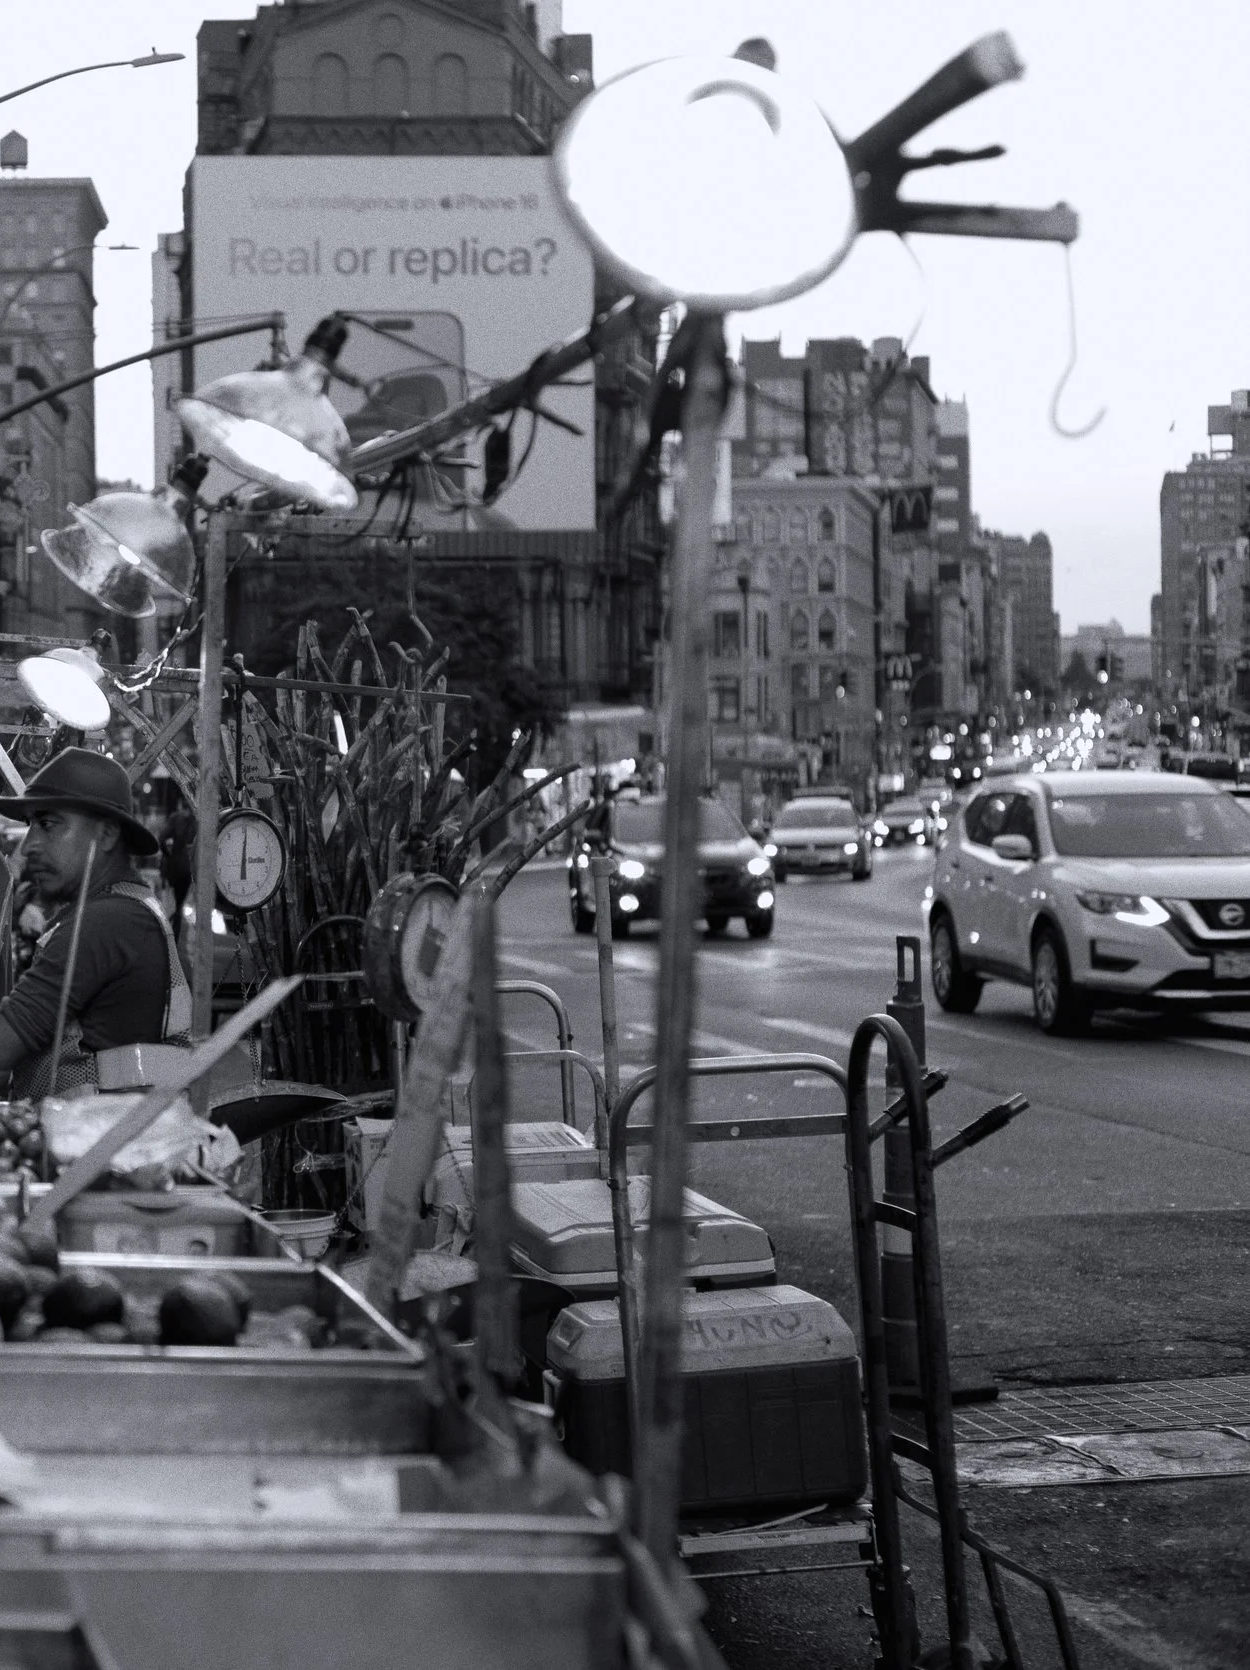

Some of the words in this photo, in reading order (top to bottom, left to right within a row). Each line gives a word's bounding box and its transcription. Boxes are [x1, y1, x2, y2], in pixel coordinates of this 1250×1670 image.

[229, 238, 320, 276] Real
[333, 246, 377, 276] or
[388, 237, 558, 285] replica?
